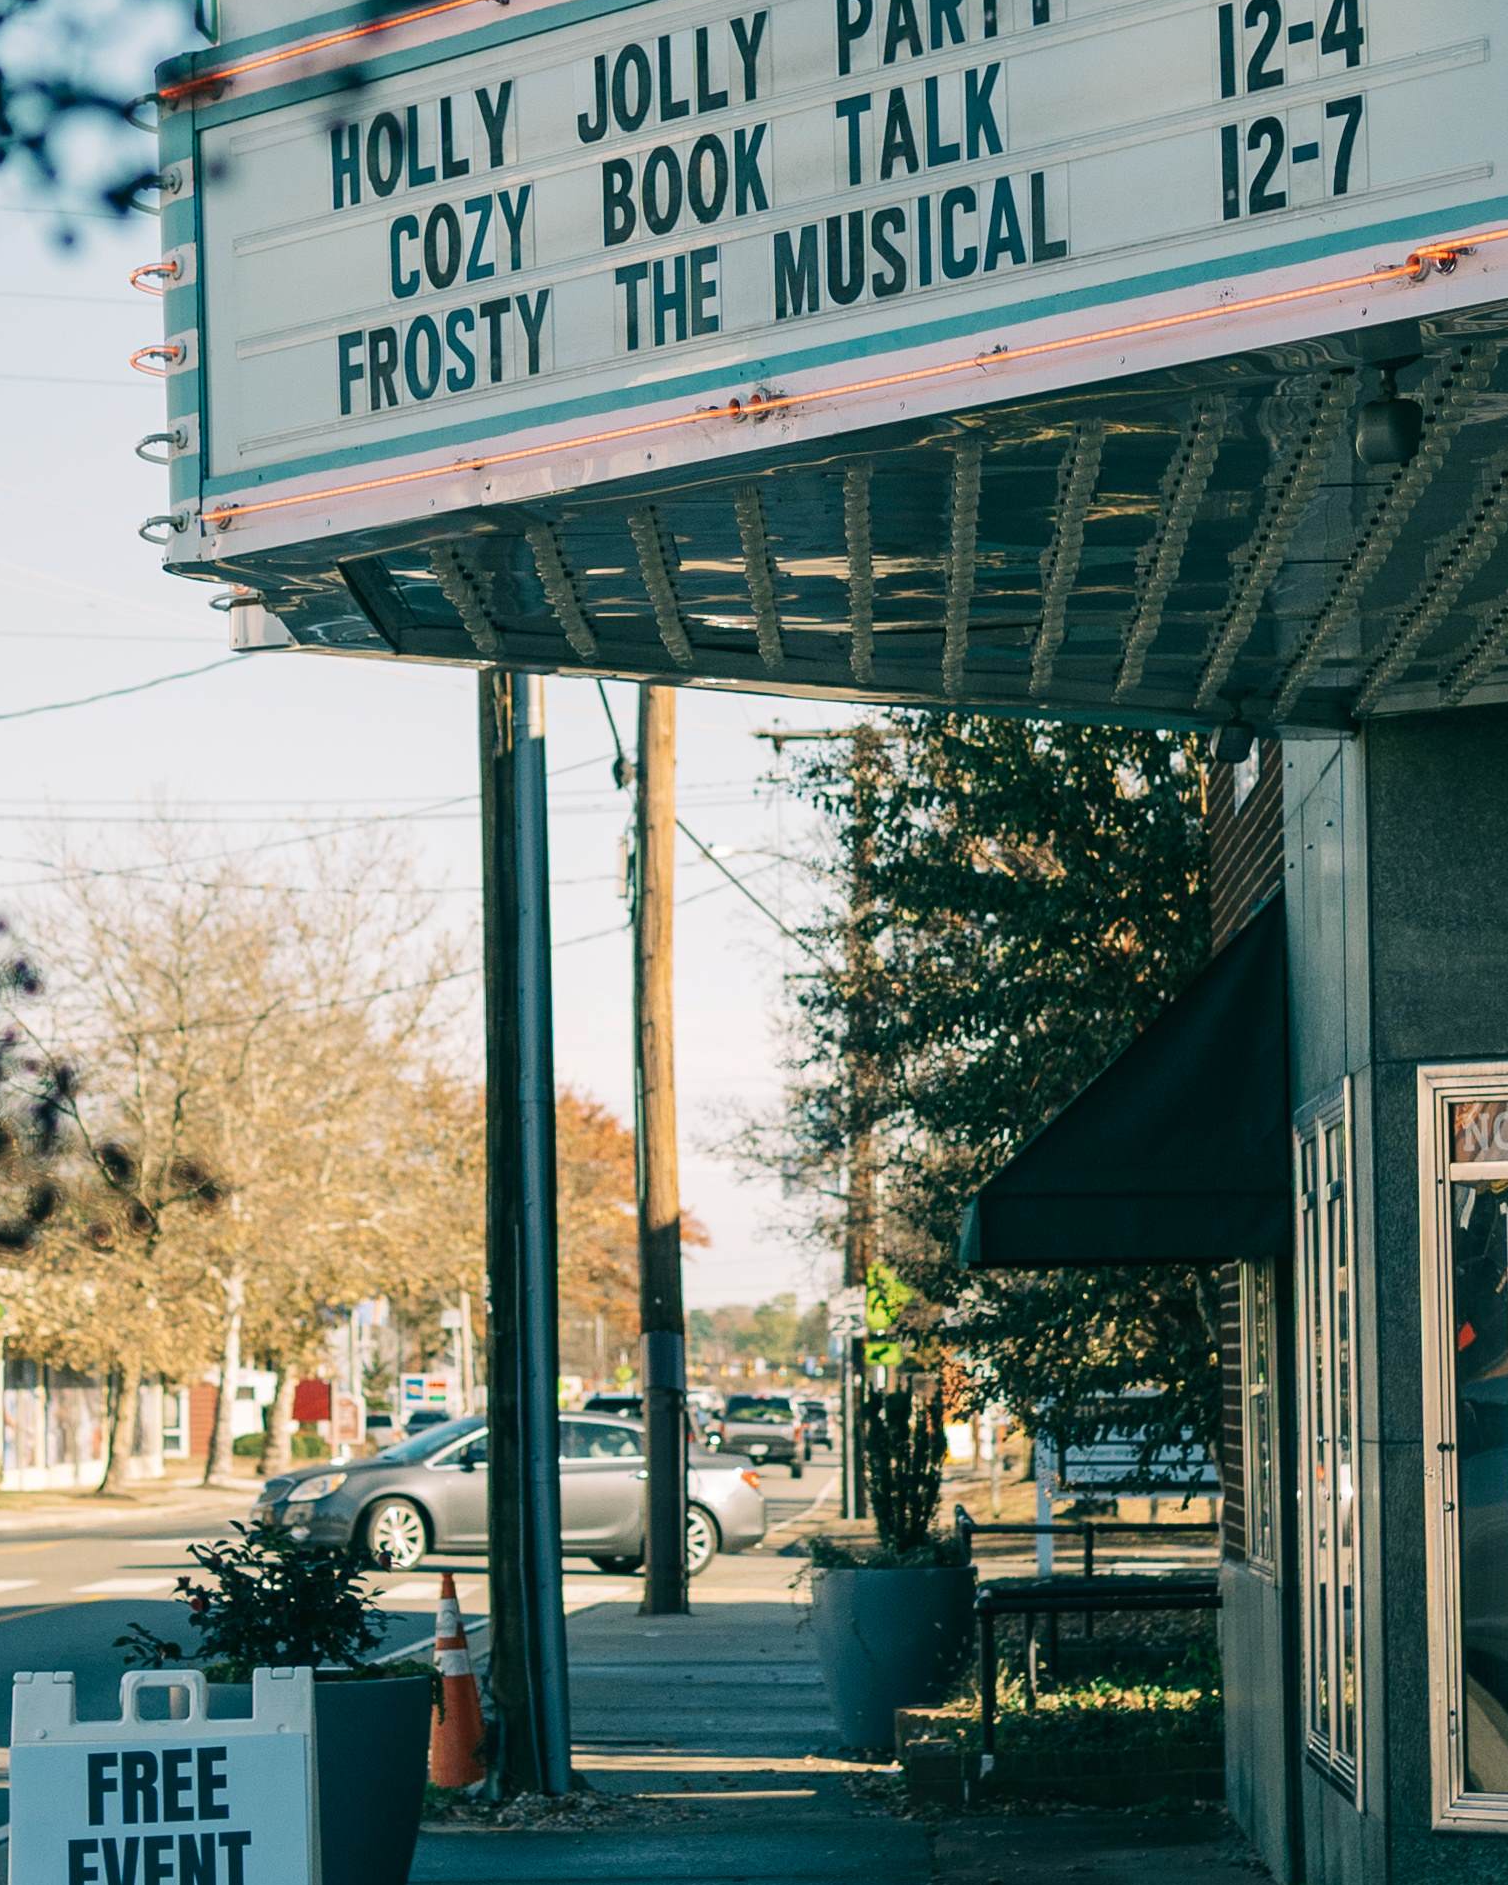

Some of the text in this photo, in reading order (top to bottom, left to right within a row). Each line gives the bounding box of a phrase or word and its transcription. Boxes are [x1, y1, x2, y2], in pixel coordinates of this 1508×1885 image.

[330, 79, 513, 210] HOLLY
[577, 10, 769, 143] JOLLY
[390, 184, 531, 299] COZY
[602, 122, 769, 247] BOOK
[836, 62, 1004, 187] TALK
[337, 95, 1364, 416] FROSTY THE MUSICAL 12-7
[88, 1746, 230, 1826] FREE
